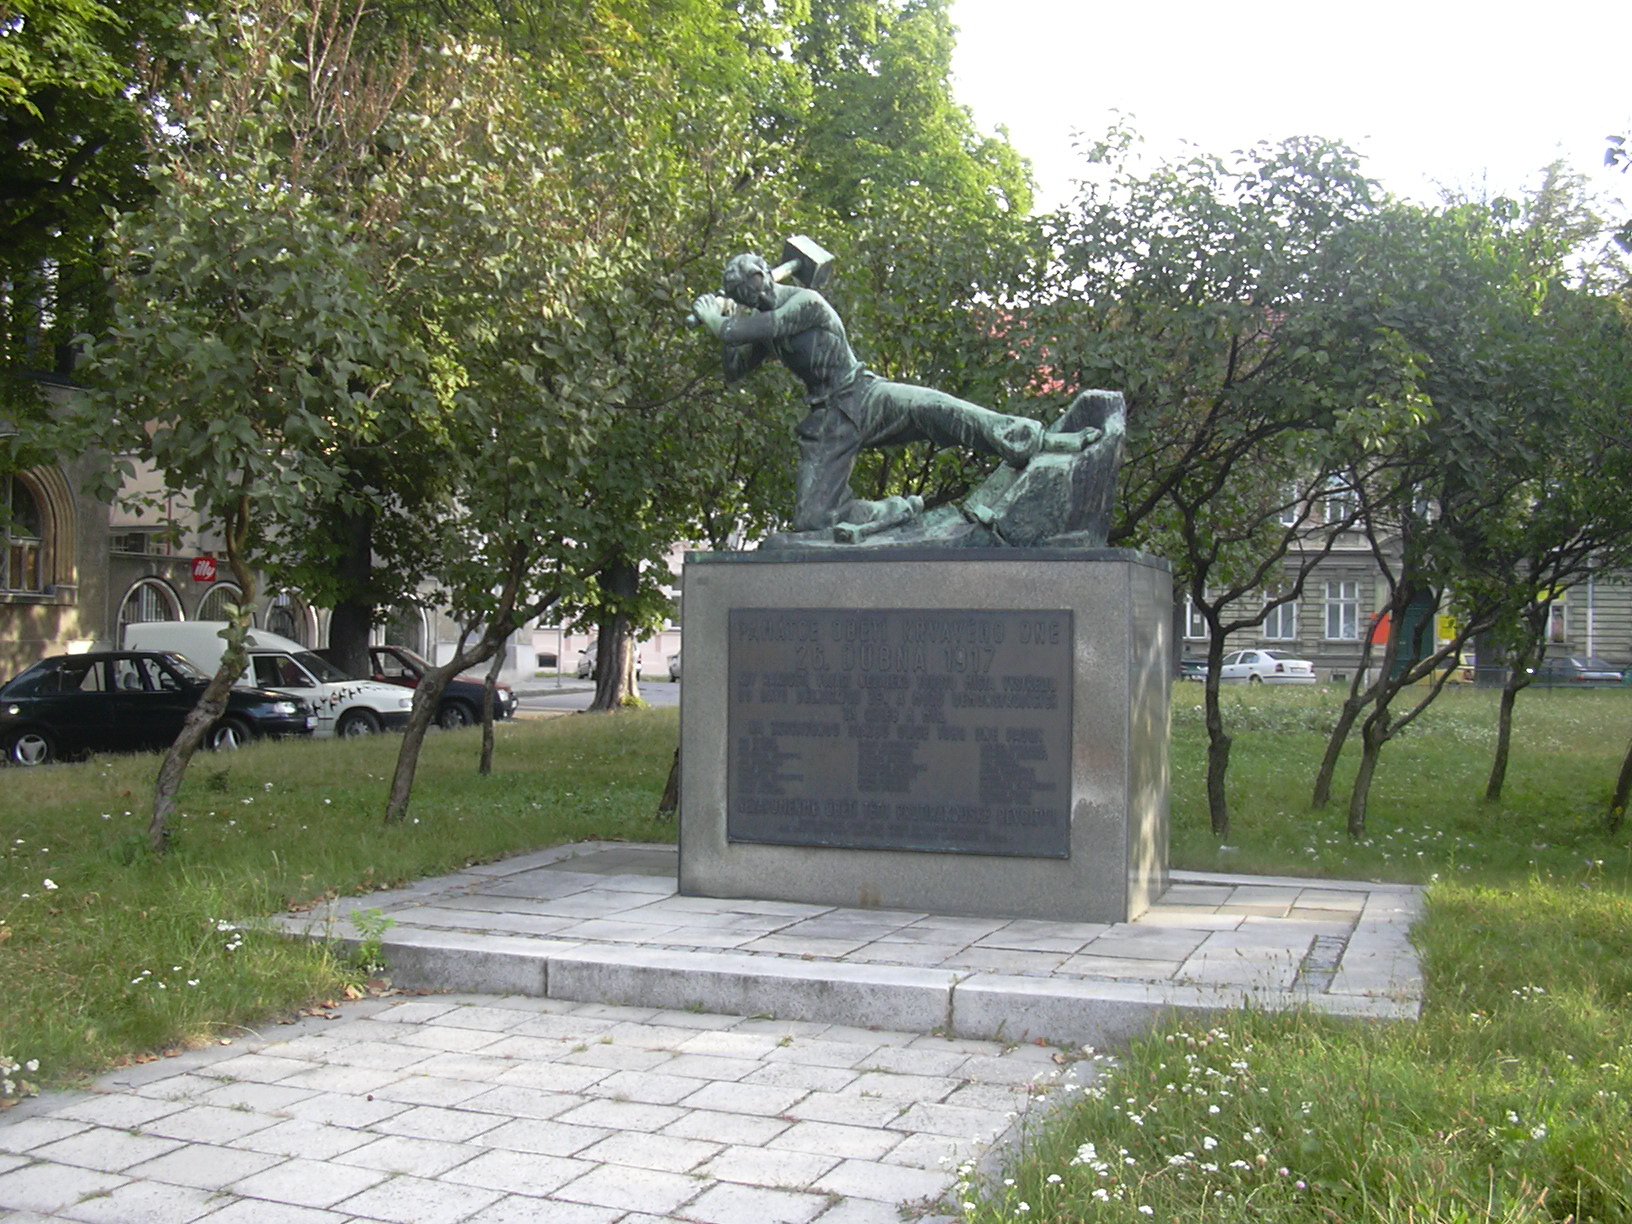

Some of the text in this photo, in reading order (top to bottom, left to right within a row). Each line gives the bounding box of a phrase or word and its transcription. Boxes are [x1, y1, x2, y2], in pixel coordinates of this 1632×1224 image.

[194, 560, 215, 580] illy
[841, 645, 926, 673] DUBNA
[943, 646, 997, 673] 1917
